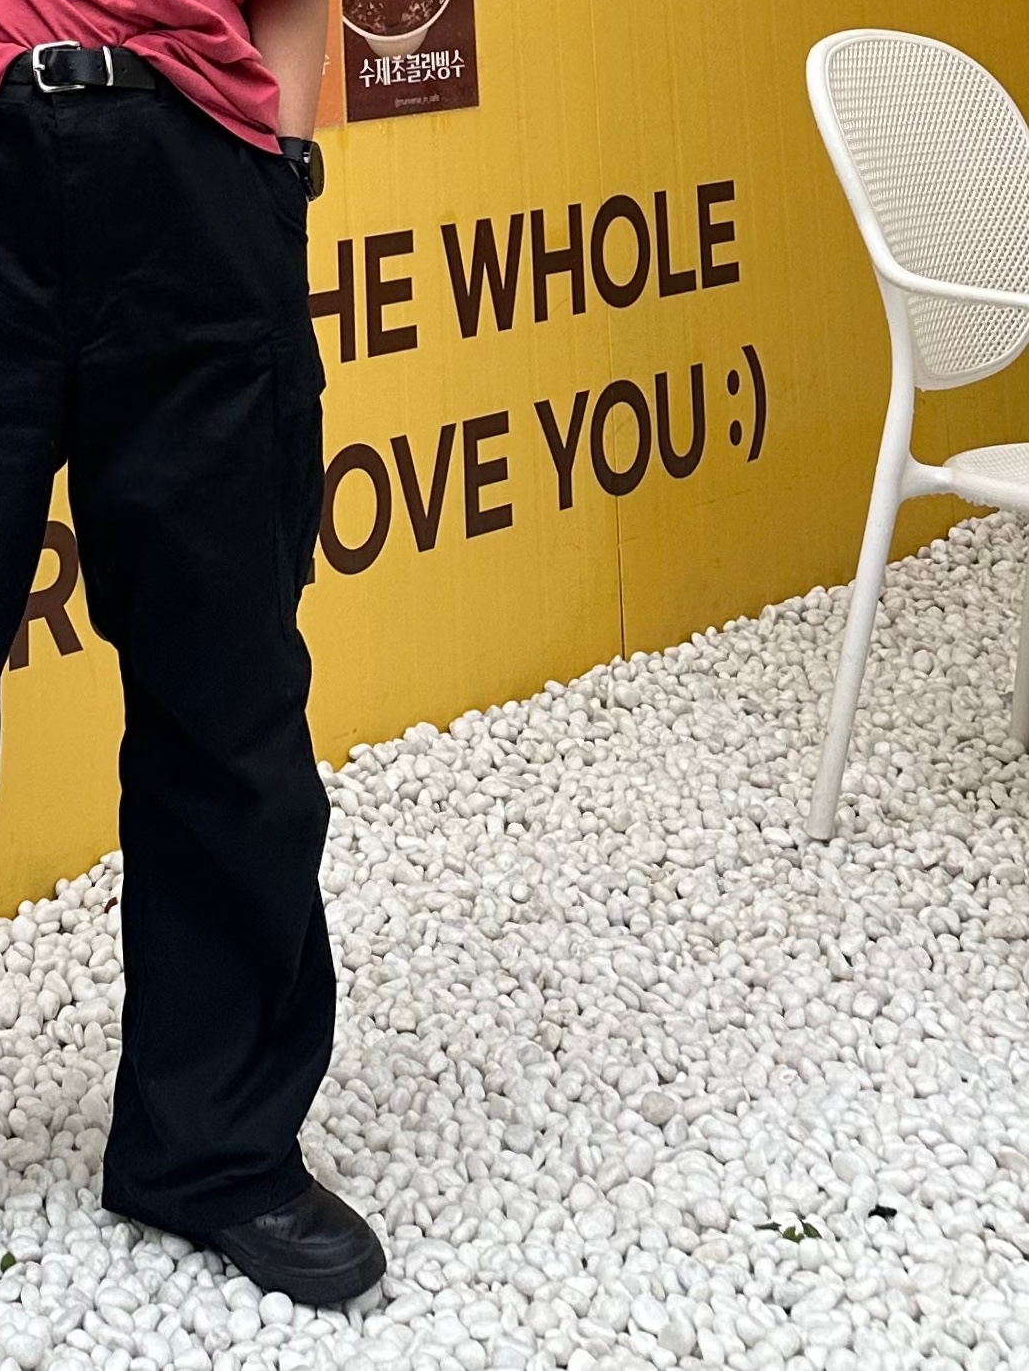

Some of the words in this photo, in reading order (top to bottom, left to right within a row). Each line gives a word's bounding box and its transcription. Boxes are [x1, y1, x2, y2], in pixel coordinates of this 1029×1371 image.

[359, 49, 466, 88] 수제초콜릿빙수
[308, 230, 418, 364] HE
[440, 180, 740, 339] WHOLE
[303, 410, 513, 584] OVE
[533, 363, 706, 510] YOU
